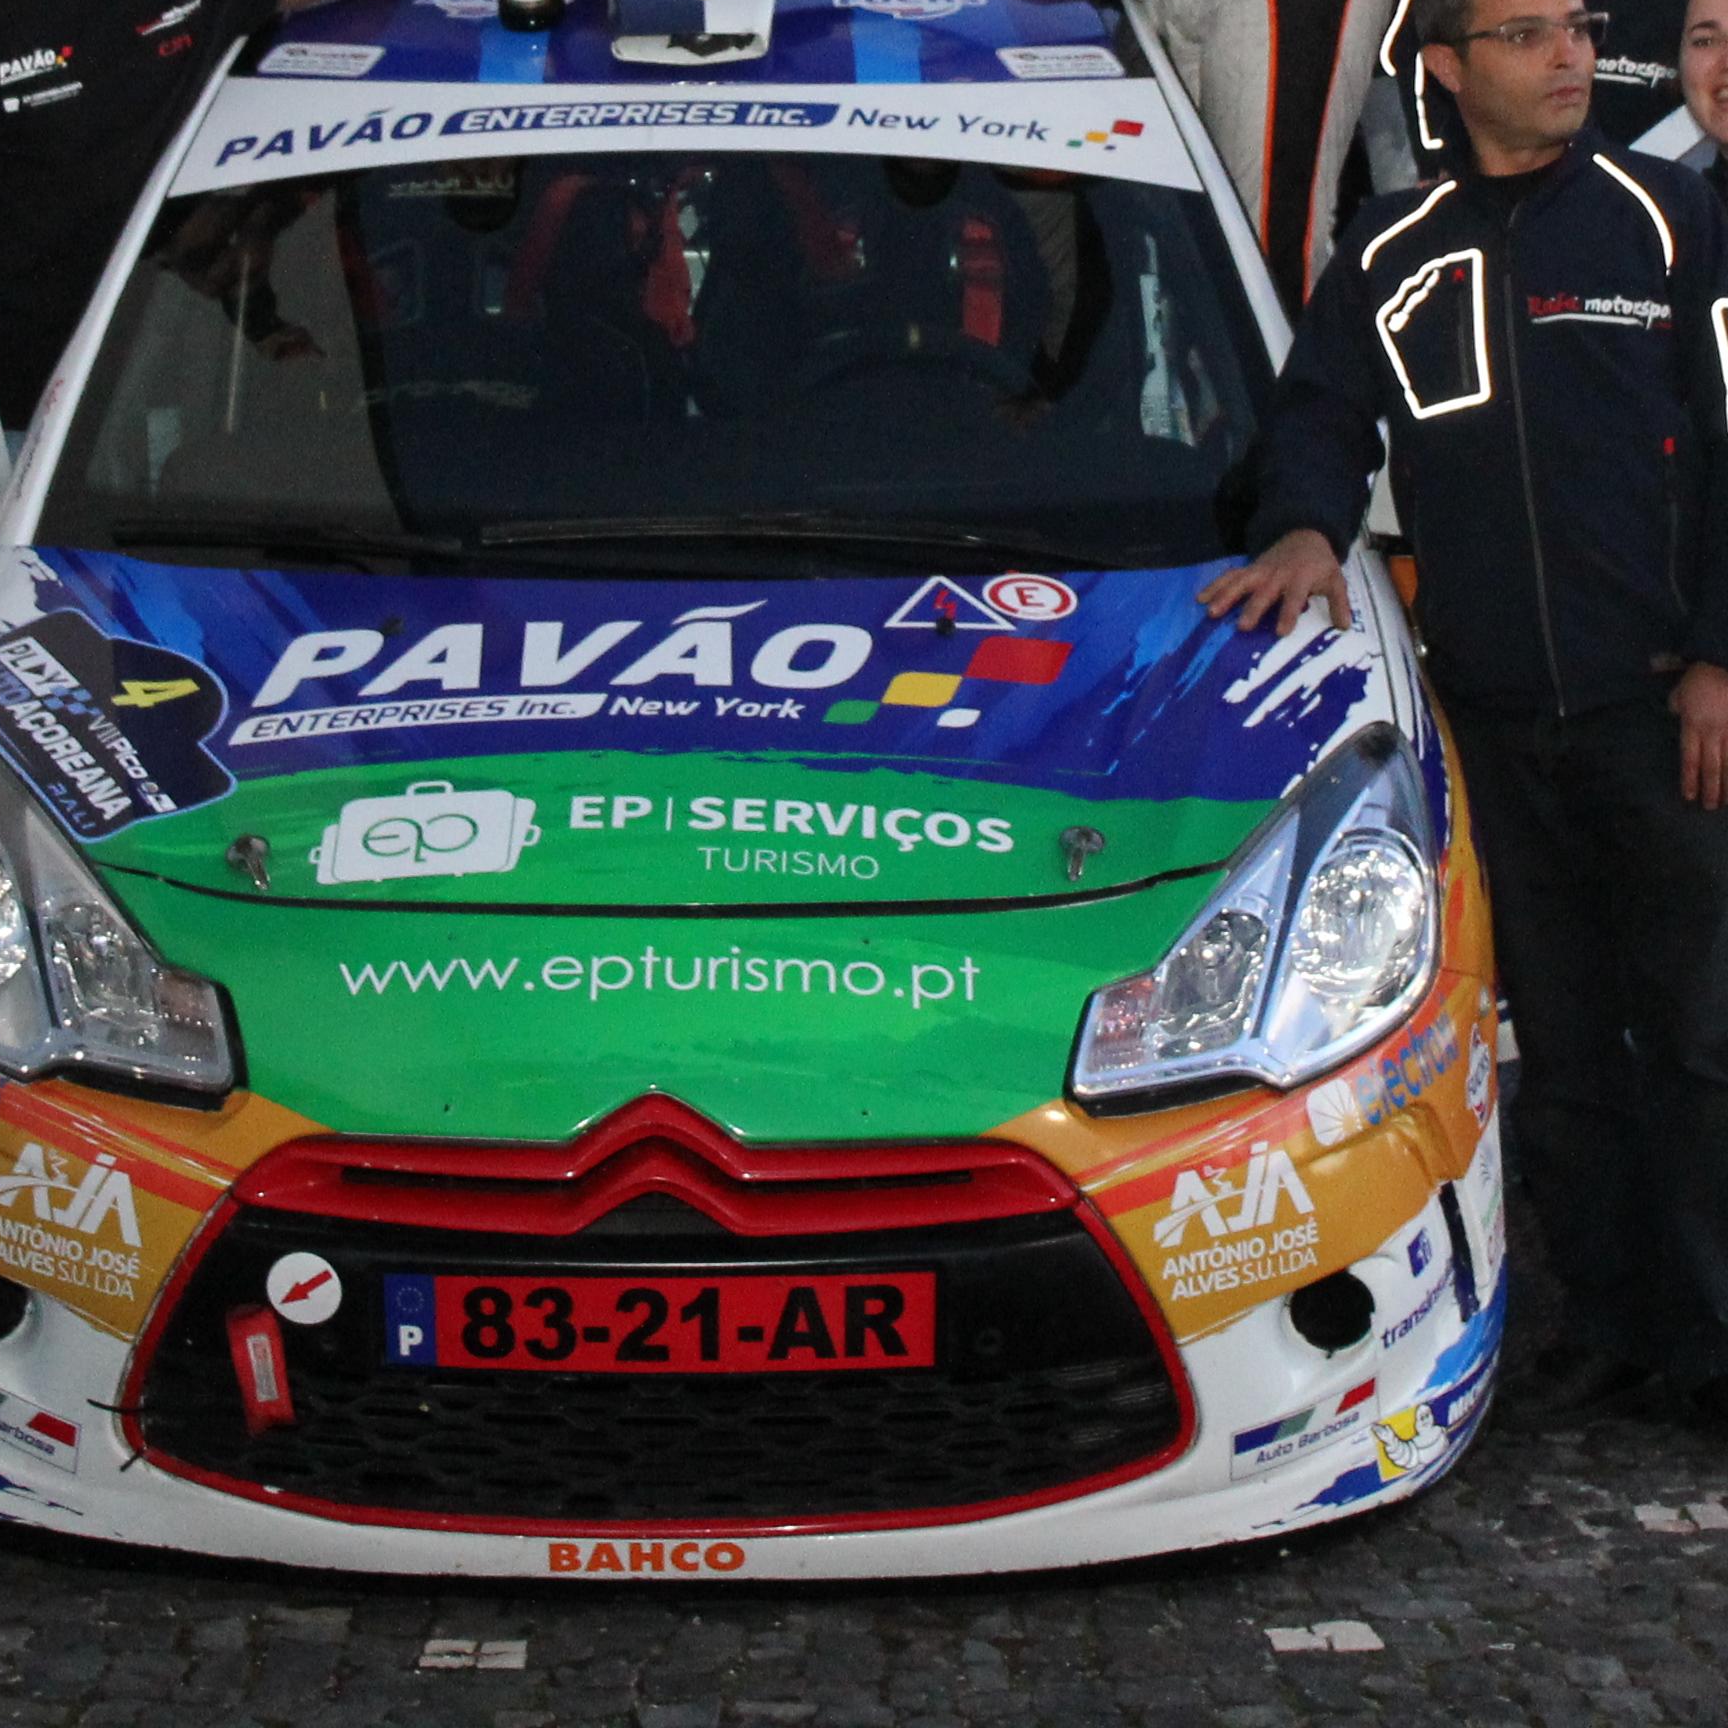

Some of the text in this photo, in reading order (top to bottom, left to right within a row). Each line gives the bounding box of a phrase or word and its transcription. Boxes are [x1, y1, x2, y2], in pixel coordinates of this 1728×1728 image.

[0, 49, 56, 79] PAVÃO
[215, 102, 1050, 167] PAVÃO ENTERPRISES Inc. New York
[1014, 586, 1045, 608] E
[252, 598, 874, 708] PAVÃO
[110, 678, 201, 708] 4
[251, 696, 806, 739] ENTERPRISES Inc. New York
[569, 795, 1016, 854] EP SERVIÇOS
[698, 847, 880, 880] TURISMO
[338, 945, 981, 1009] www.epturismo.pt
[86, 1246, 141, 1280] JOSÉ
[1162, 1216, 1320, 1280] ANTÓNIO JOSÉ
[94, 1272, 135, 1302] LDA
[1172, 1266, 1241, 1301] ALVES
[1279, 1248, 1319, 1274] LDA
[398, 1326, 424, 1356] P
[460, 1283, 909, 1363] 83-21-AR
[1255, 1442, 1294, 1465] Auto
[1298, 1411, 1360, 1448] Barbosa
[548, 1542, 747, 1573] BAHCO
